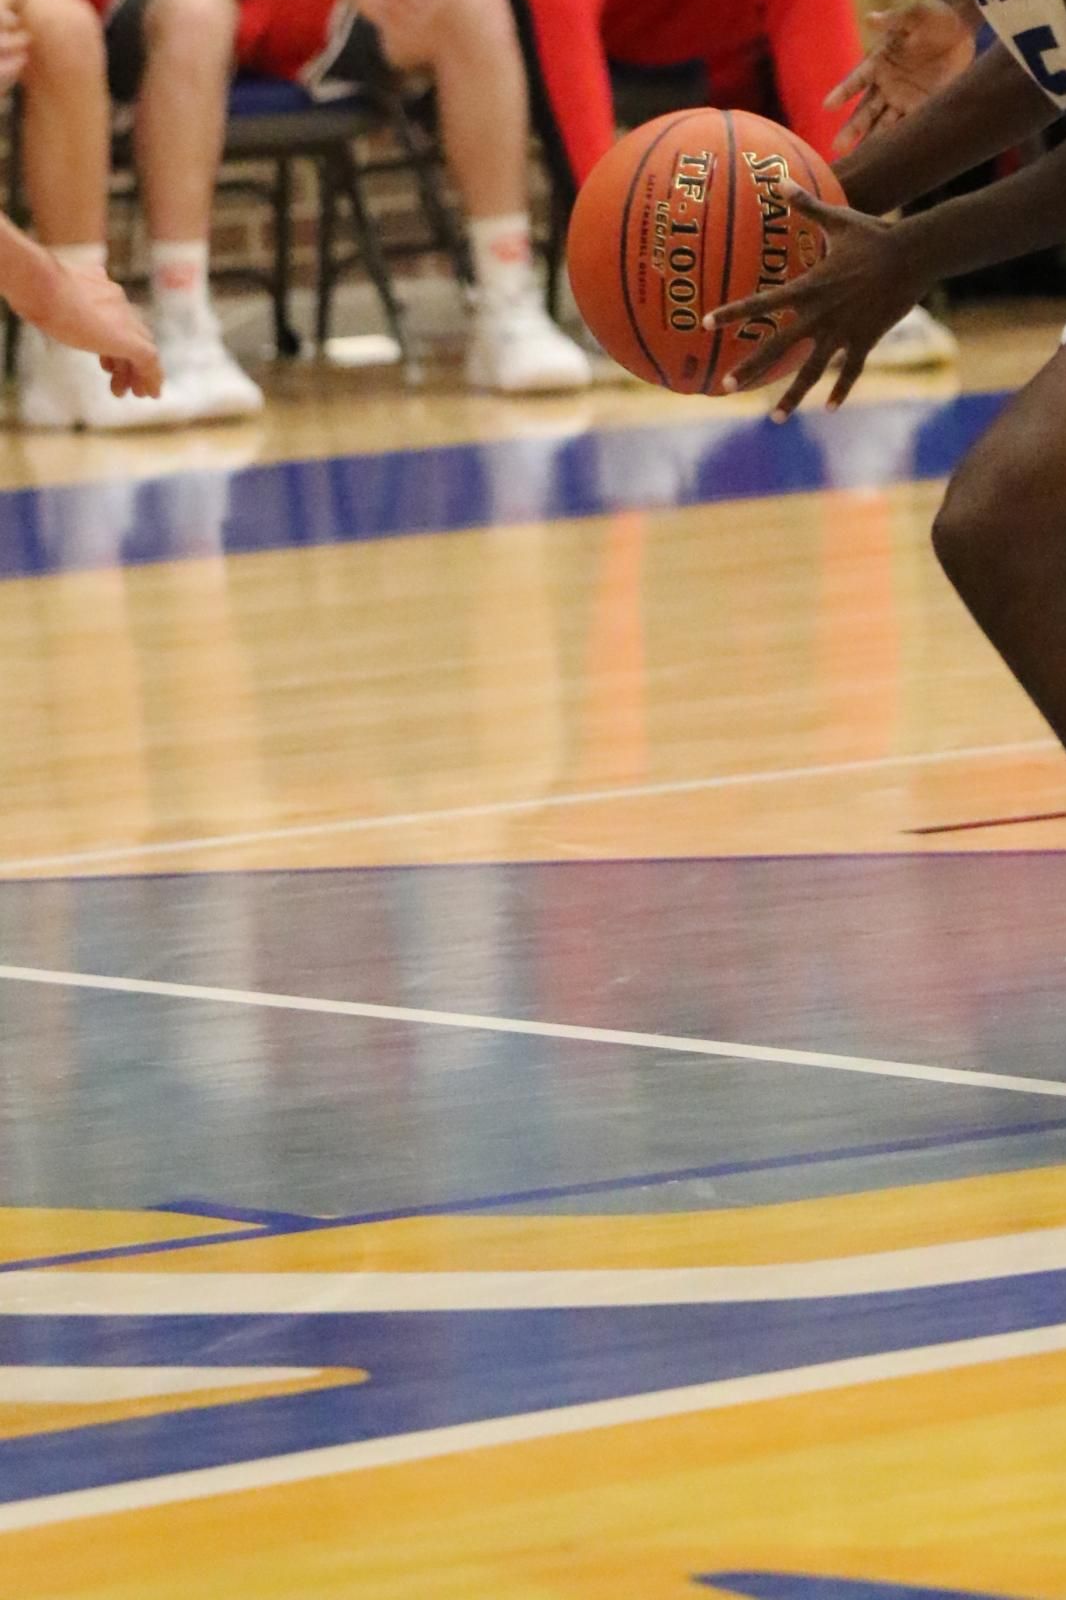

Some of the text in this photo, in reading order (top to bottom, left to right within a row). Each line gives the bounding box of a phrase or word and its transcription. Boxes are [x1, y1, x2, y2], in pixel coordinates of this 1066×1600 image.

[651, 199, 670, 276] LEGACY
[665, 150, 713, 334] TF-1000
[734, 151, 791, 342] SPALDIG
